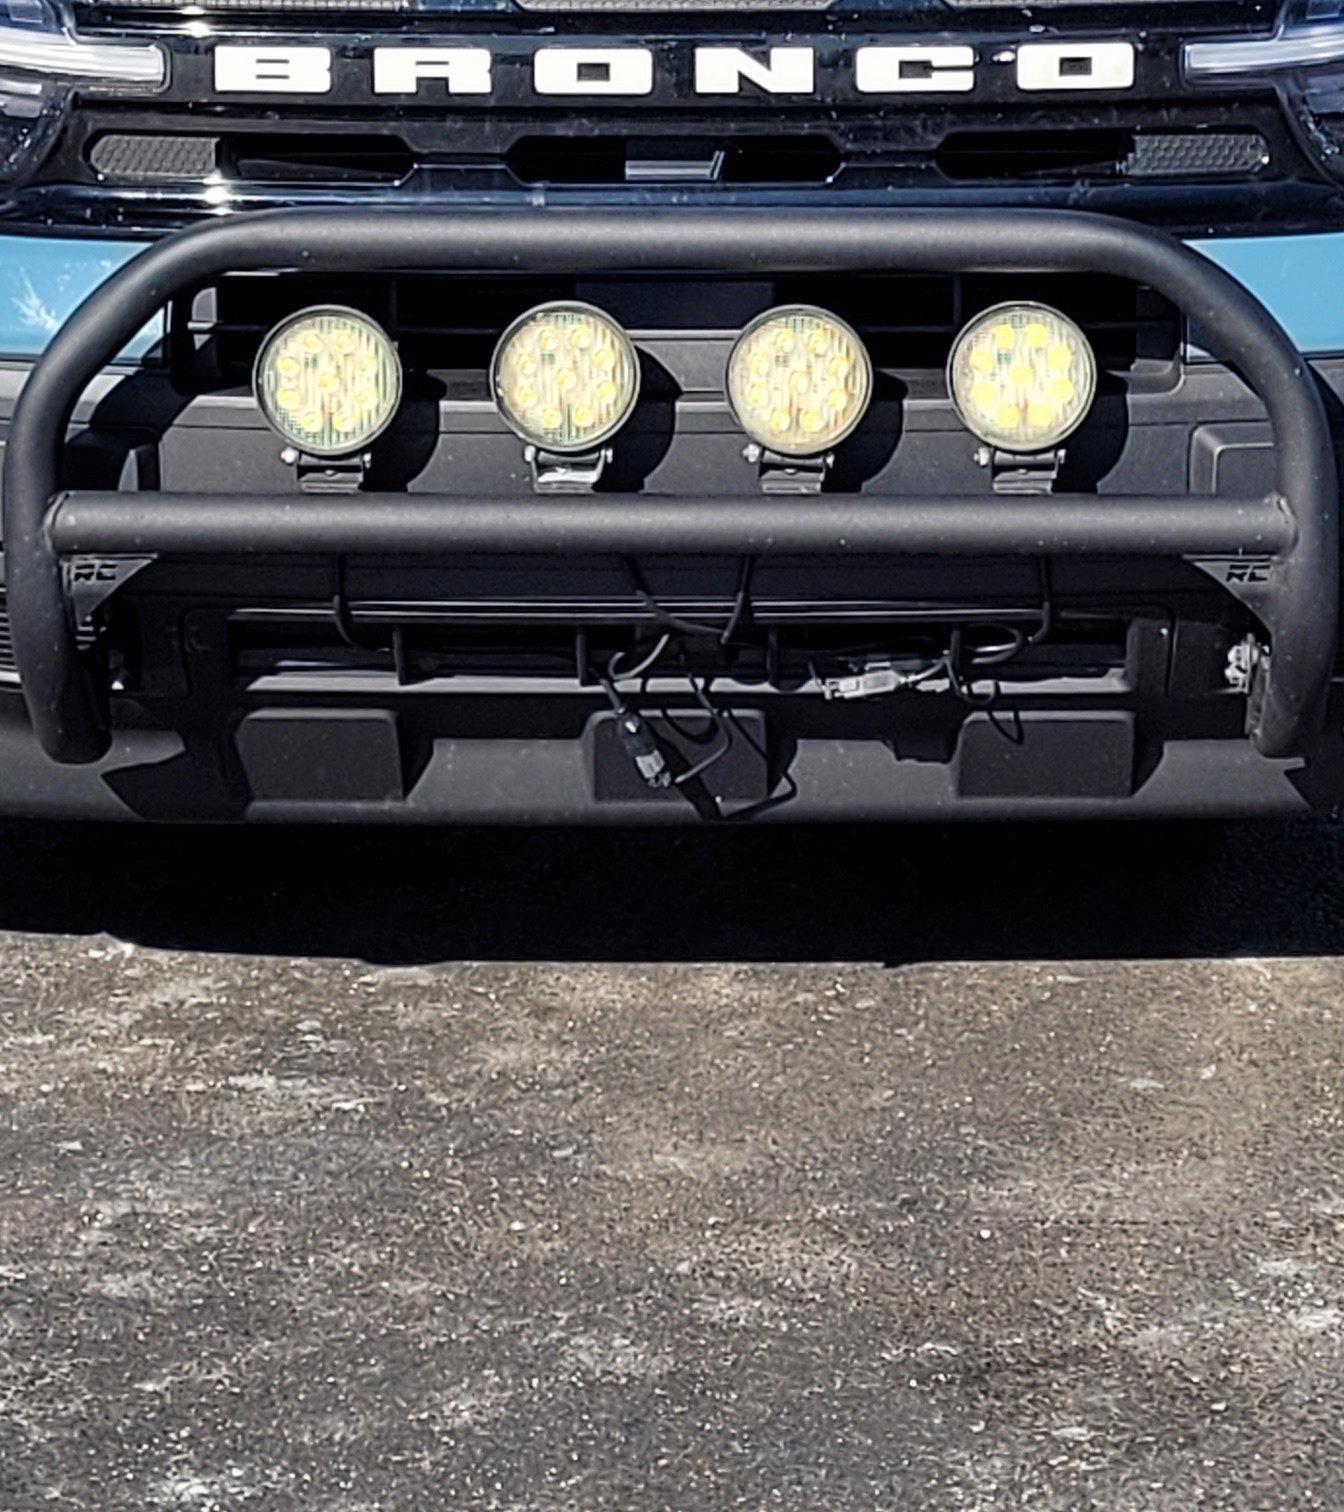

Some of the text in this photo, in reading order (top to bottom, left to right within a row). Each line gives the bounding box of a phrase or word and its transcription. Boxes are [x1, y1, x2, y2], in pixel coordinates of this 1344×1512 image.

[213, 42, 1135, 95] BRONCO
[74, 563, 118, 582] RC
[1225, 564, 1271, 583] RC
